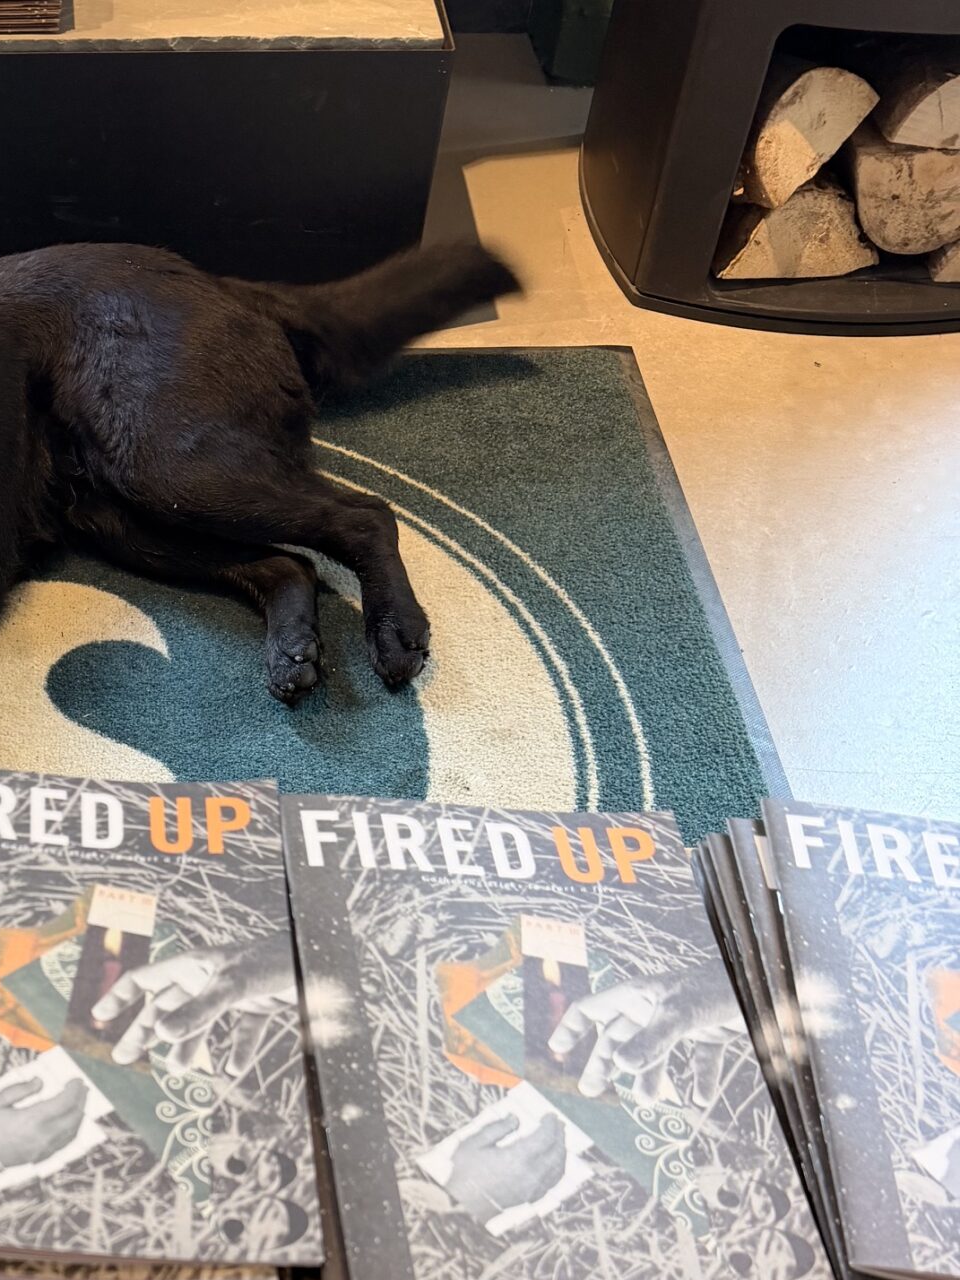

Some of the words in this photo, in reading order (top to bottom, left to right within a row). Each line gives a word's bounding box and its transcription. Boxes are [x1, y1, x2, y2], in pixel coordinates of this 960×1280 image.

[149, 795, 252, 856] UP
[298, 809, 537, 880] FIRED
[553, 826, 656, 885] UP
